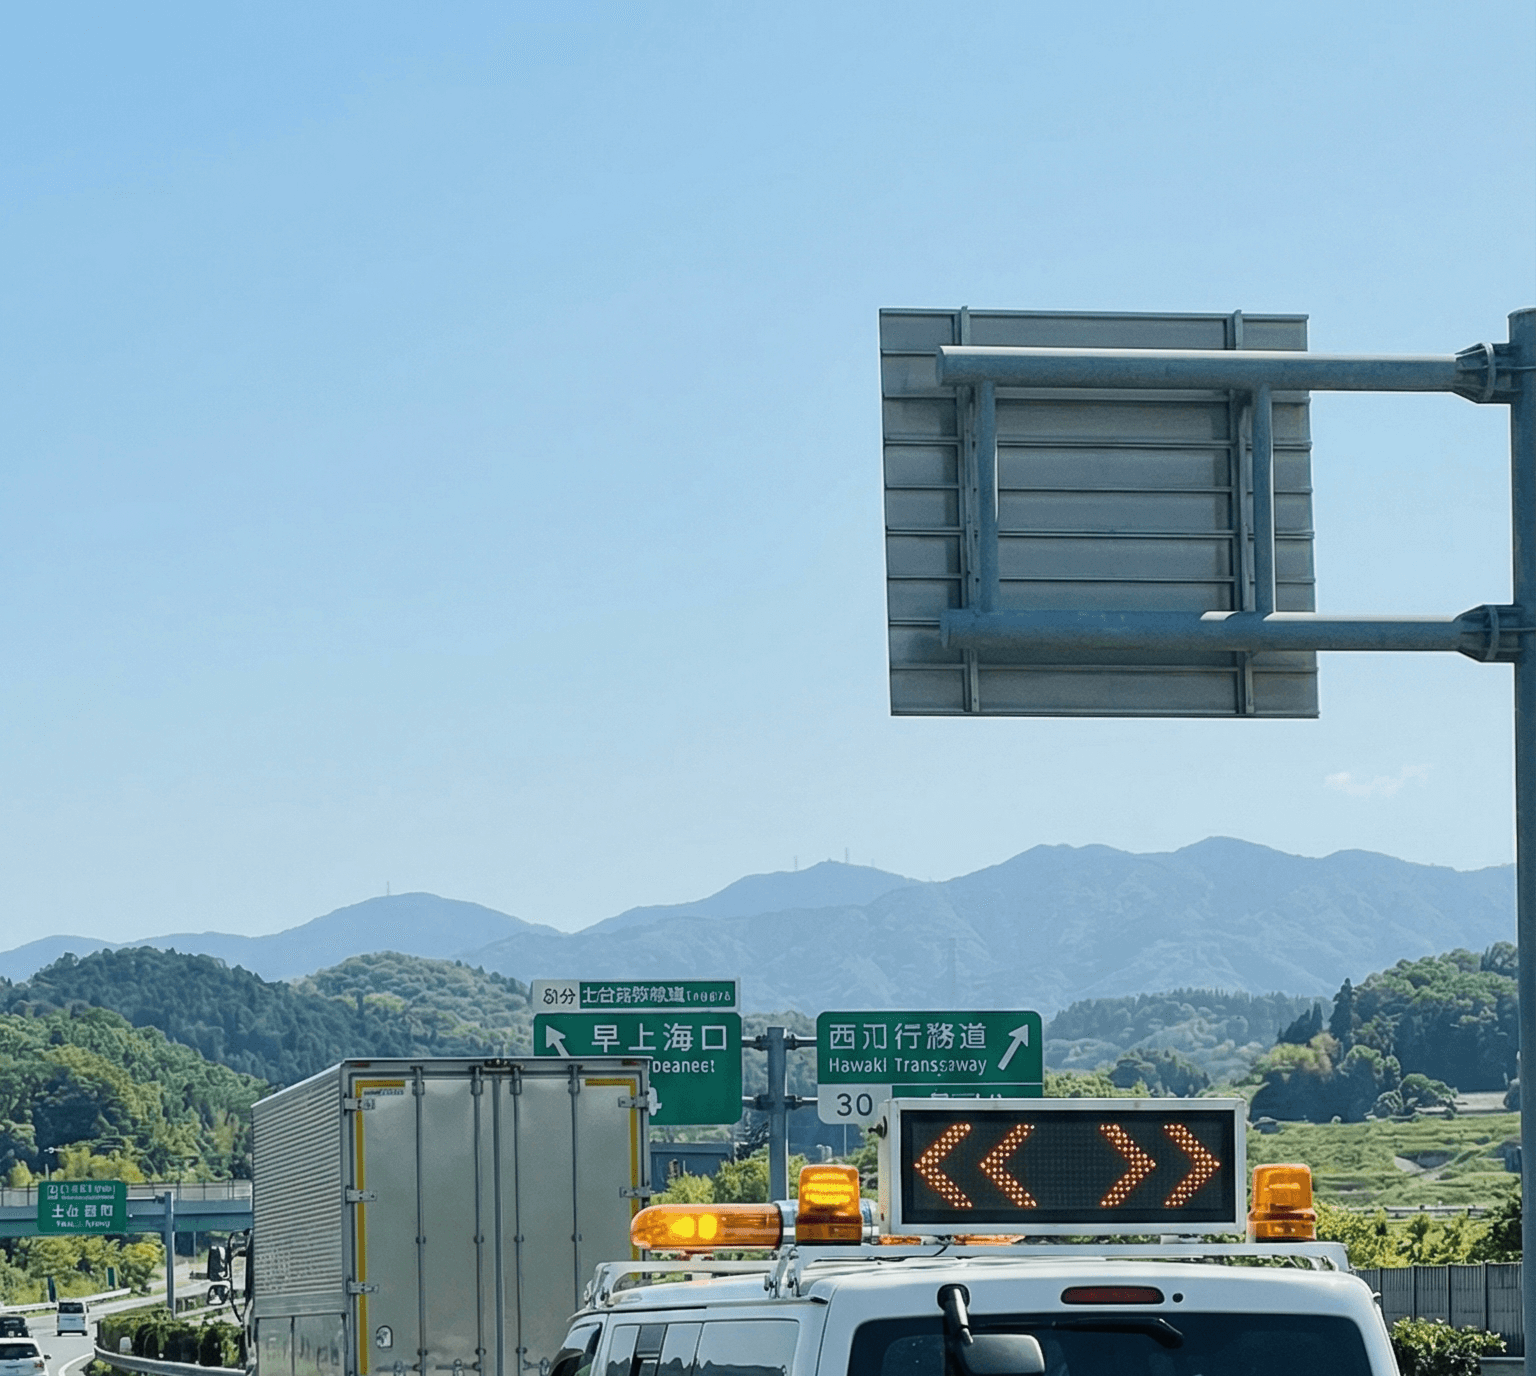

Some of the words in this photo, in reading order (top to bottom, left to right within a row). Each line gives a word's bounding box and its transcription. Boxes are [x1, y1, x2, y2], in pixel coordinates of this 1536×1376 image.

[591, 1022, 727, 1053] 早上海口
[836, 1093, 873, 1116] 30
